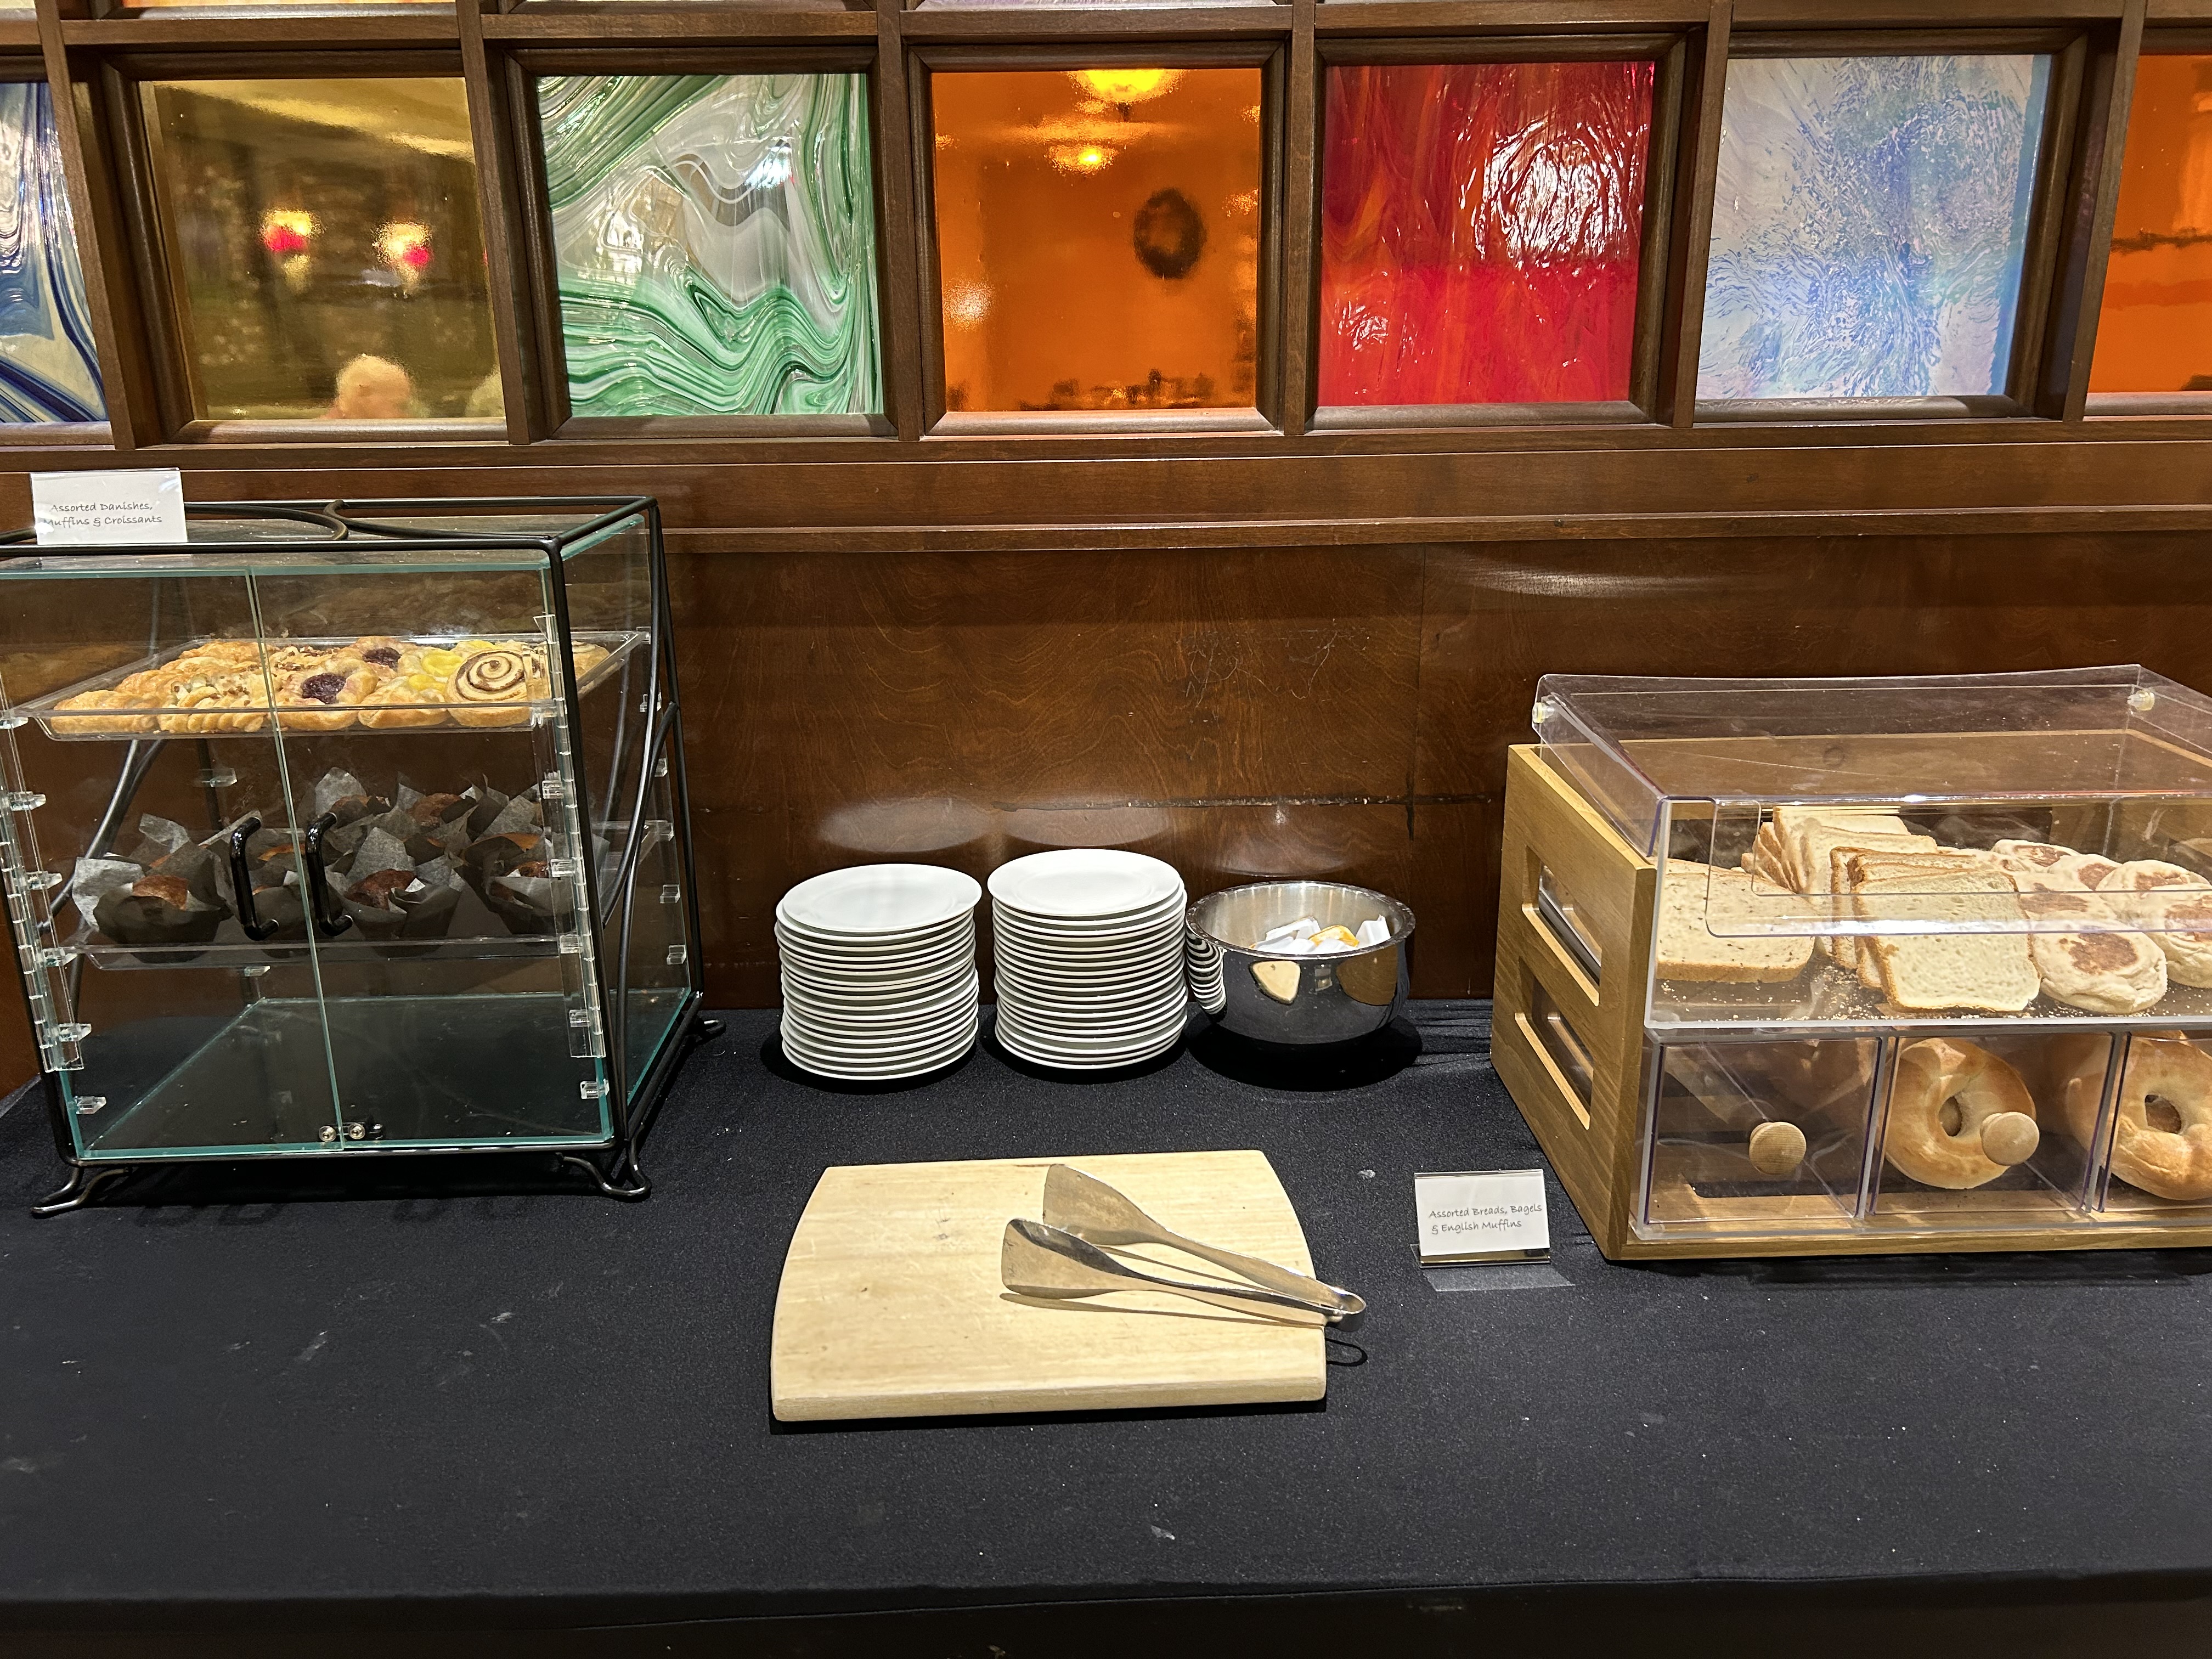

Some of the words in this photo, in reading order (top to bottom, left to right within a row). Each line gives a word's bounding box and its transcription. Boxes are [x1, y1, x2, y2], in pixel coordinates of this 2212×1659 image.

[49, 503, 97, 512] Assorted
[100, 501, 153, 511] Danishes,
[93, 517, 101, 527] &
[105, 515, 162, 524] Croissants
[1429, 1208, 1469, 1218] Assorted
[1471, 1205, 1508, 1215] Breads,
[1510, 1203, 1542, 1215] Bagels
[1431, 1226, 1438, 1234] &
[1441, 1221, 1479, 1234] English
[1482, 1219, 1522, 1231] Muffins
